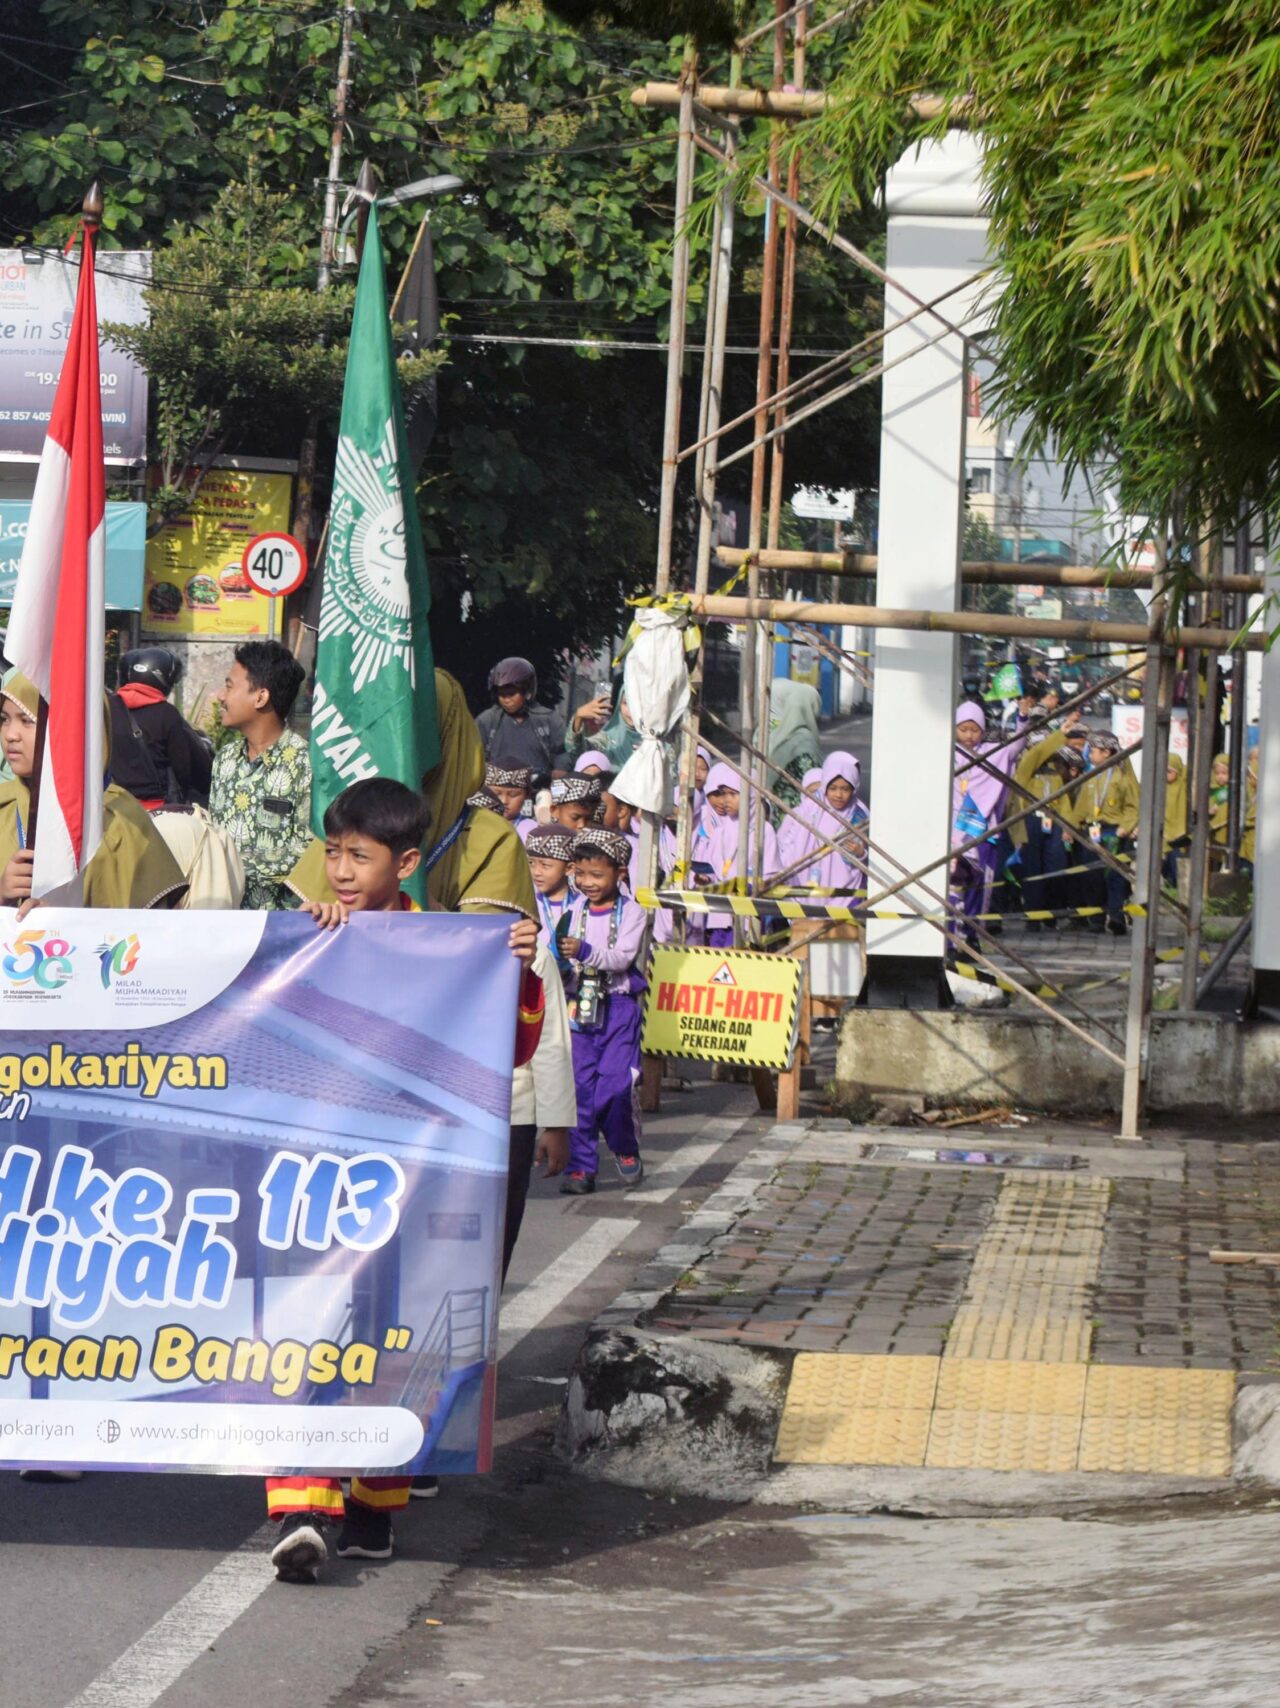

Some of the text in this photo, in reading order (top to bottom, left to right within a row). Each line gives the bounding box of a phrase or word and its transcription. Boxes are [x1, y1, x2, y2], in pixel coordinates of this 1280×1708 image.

[23, 319, 42, 339] in
[49, 321, 71, 340] St
[12, 411, 30, 421] 857
[32, 412, 51, 421] 405
[252, 548, 283, 580] 40
[115, 988, 187, 996] MUHAMMADIYAH
[656, 982, 784, 1023] HATI-HATI
[680, 1016, 753, 1036] SEDANG ADA
[681, 1033, 747, 1053] PEKERJAAN
[45, 1144, 173, 1240] ke
[258, 1151, 405, 1252] 113
[130, 1424, 390, 1446] www.sdmuhjogokariyan.sch.id
